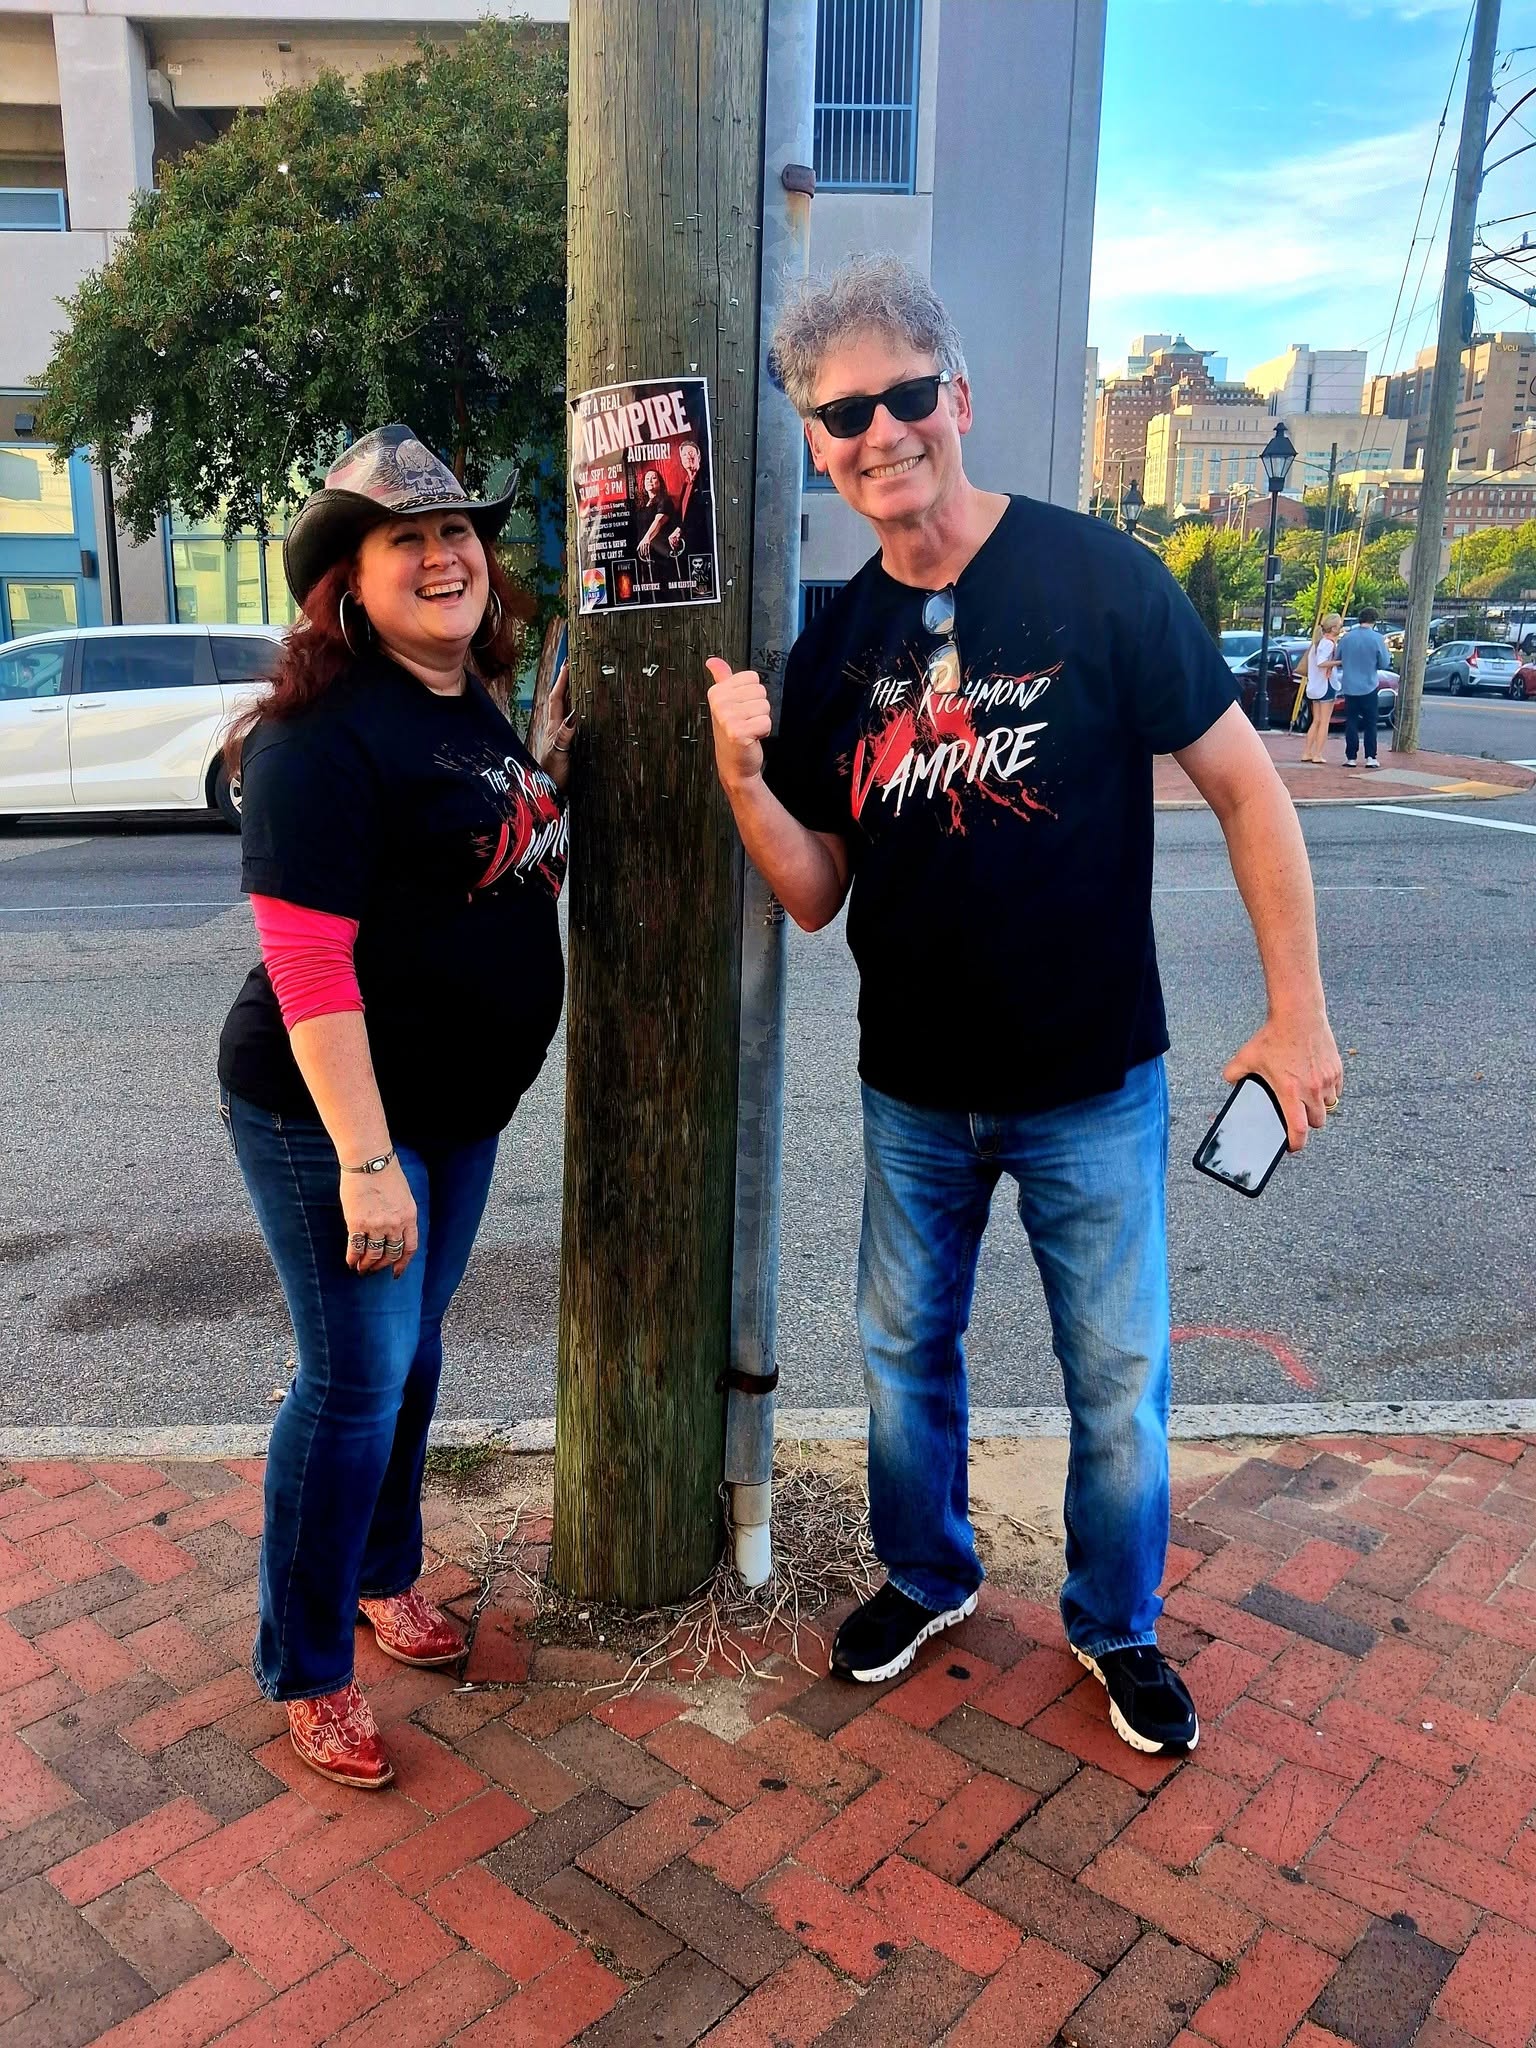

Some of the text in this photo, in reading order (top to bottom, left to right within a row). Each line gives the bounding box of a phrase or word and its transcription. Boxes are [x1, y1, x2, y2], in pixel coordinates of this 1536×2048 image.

[1502, 344, 1519, 352] VCU
[593, 397, 599, 414] A
[600, 392, 623, 412] REAL
[581, 389, 692, 463] VAMPIRE
[627, 442, 671, 463] AUTHOR!
[590, 467, 606, 482] SEPT.
[604, 482, 610, 495] 3
[611, 480, 623, 494] PM
[870, 676, 912, 709] THE
[850, 708, 1049, 821] VAMPIRE
[480, 767, 510, 794] THE
[475, 793, 569, 889] VAMPIR
